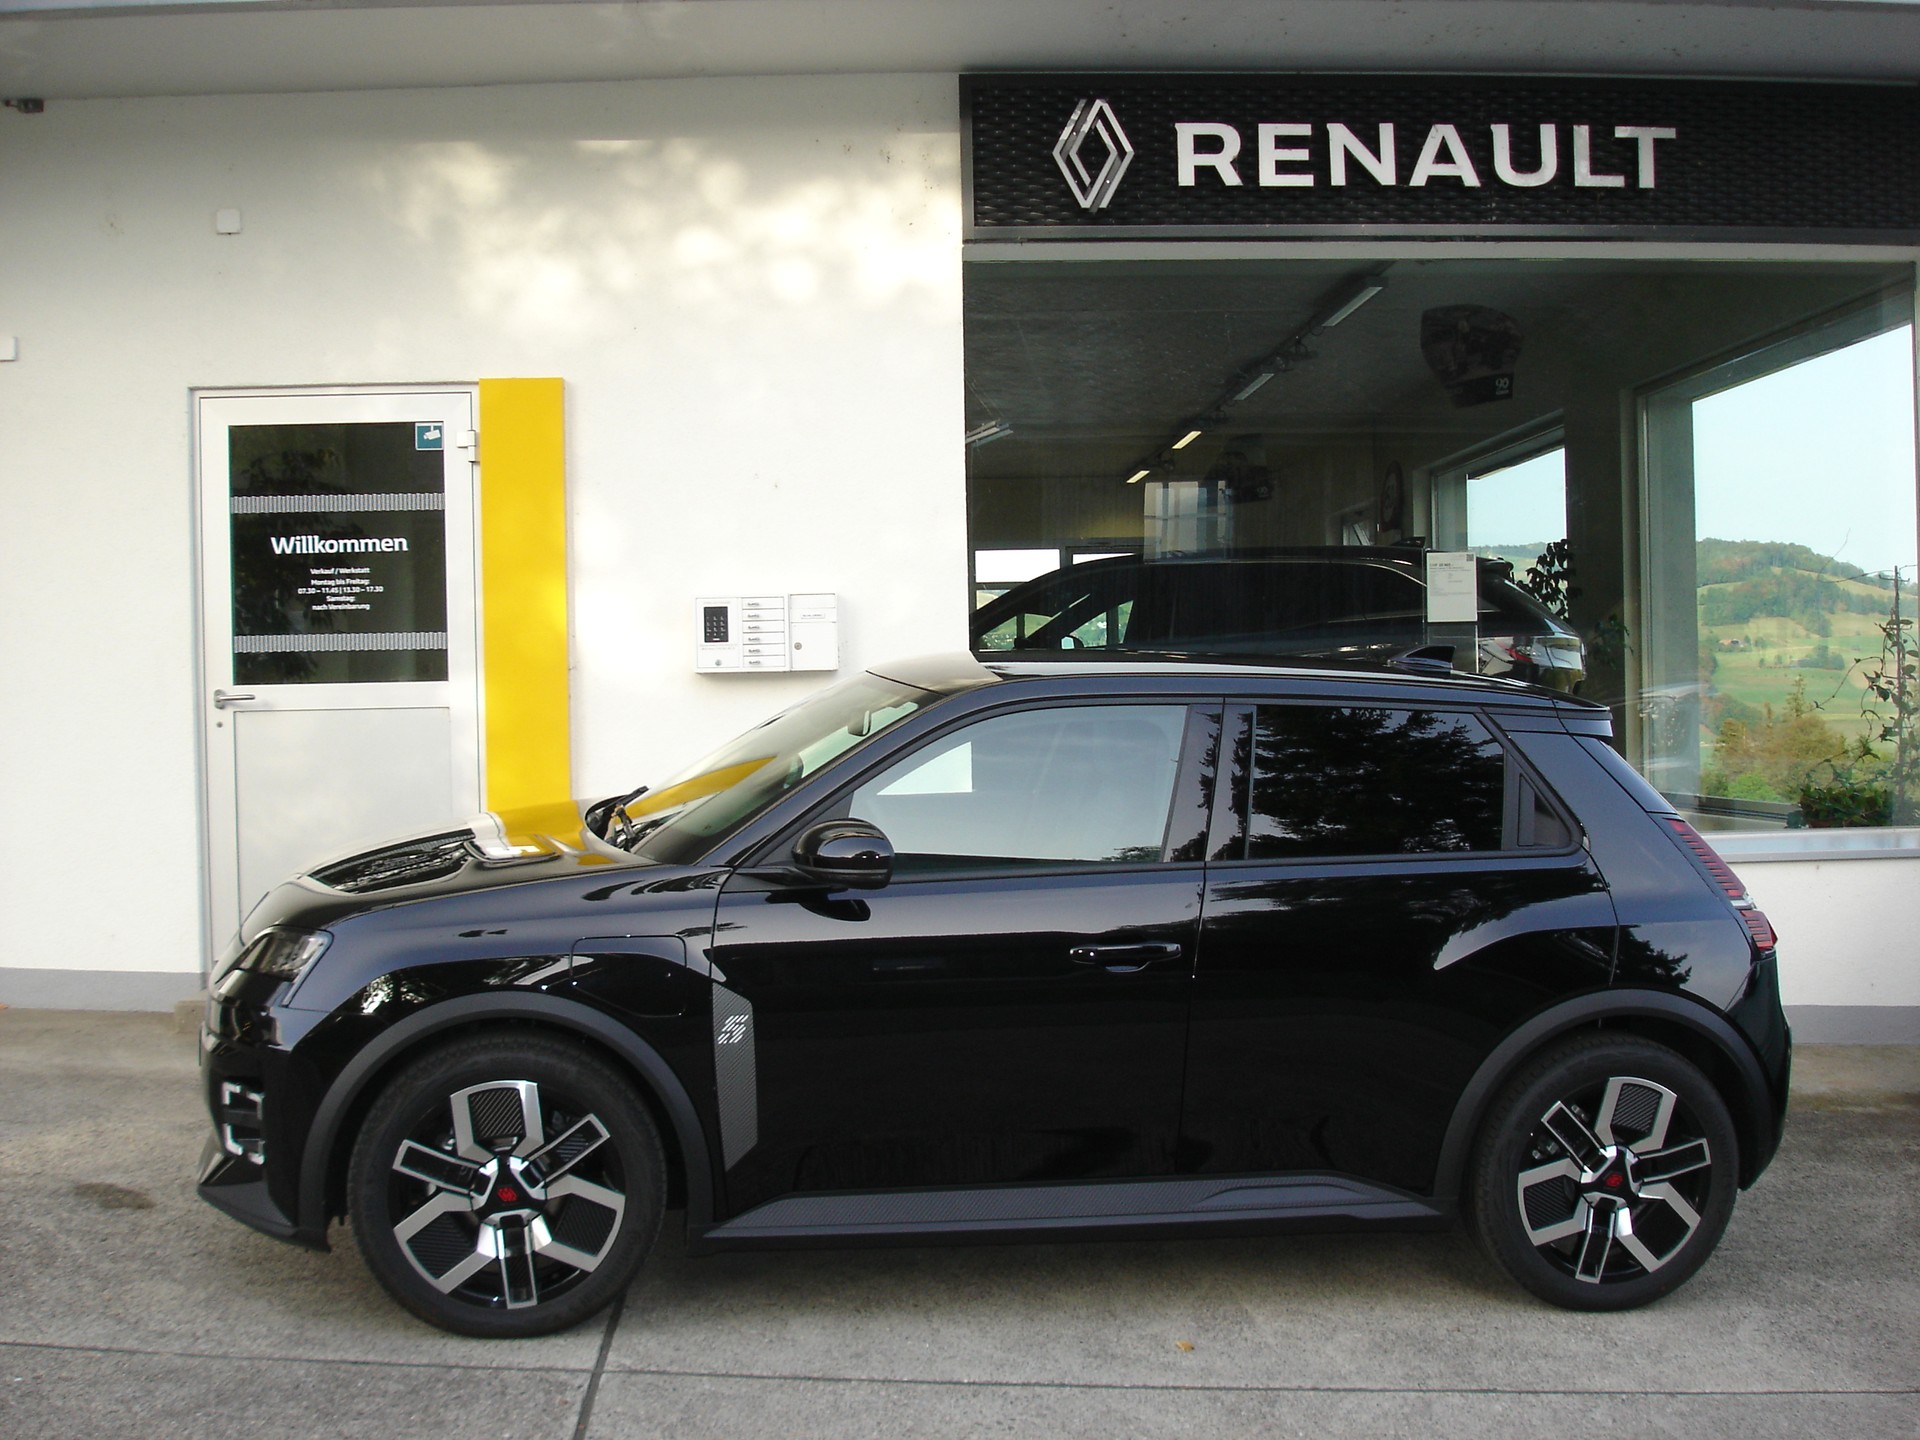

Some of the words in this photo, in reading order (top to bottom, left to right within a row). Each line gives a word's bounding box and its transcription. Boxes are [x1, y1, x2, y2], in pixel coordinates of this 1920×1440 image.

[1175, 122, 1677, 189] RENAULT
[1495, 377, 1510, 389] 90
[270, 535, 408, 554] Willkommen
[311, 579, 335, 587] Montag
[343, 586, 361, 594] 13.30
[328, 603, 370, 611] Vereinbarung
